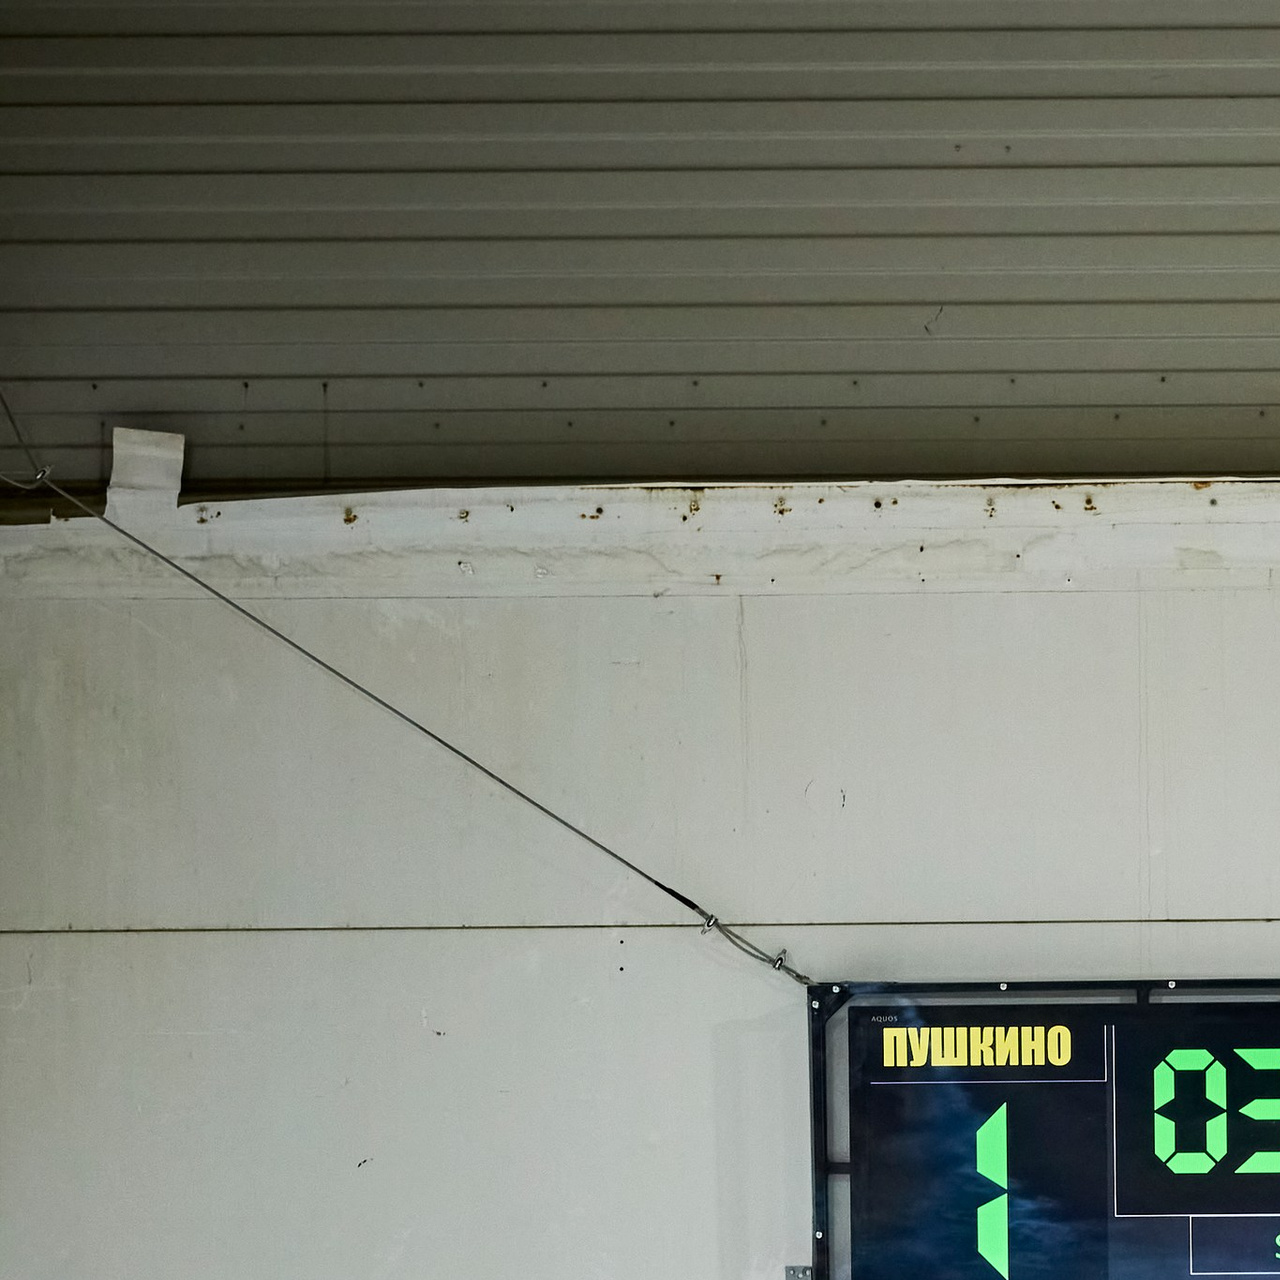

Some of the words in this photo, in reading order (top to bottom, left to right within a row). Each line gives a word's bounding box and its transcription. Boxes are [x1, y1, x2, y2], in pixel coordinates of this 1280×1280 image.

[870, 1015, 899, 1023] AQUOS
[883, 1025, 1072, 1067] ПУШКИНО
[975, 1102, 1009, 1280] 1
